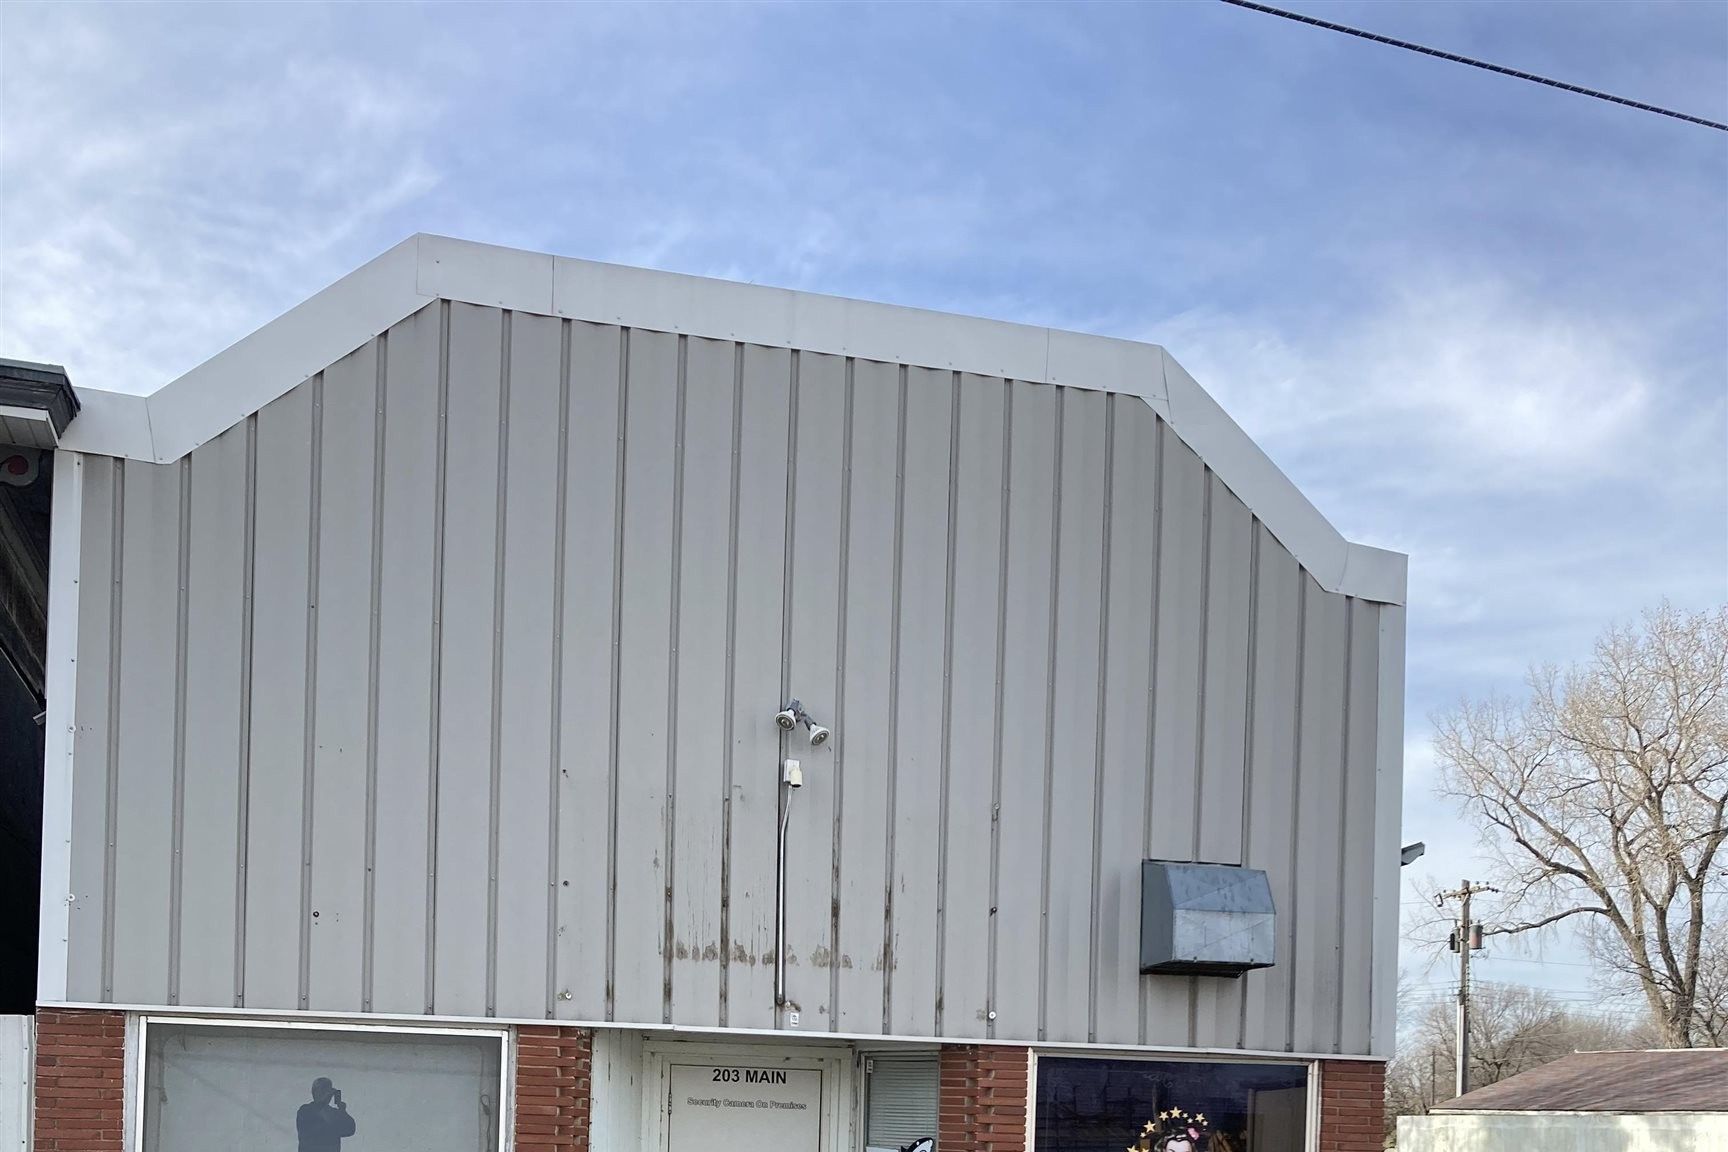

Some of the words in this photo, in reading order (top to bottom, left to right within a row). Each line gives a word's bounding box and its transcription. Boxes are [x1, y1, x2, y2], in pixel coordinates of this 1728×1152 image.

[712, 1068, 740, 1083] 203
[745, 1070, 787, 1085] MAIN
[687, 1097, 722, 1108] Security
[755, 1100, 769, 1109] On
